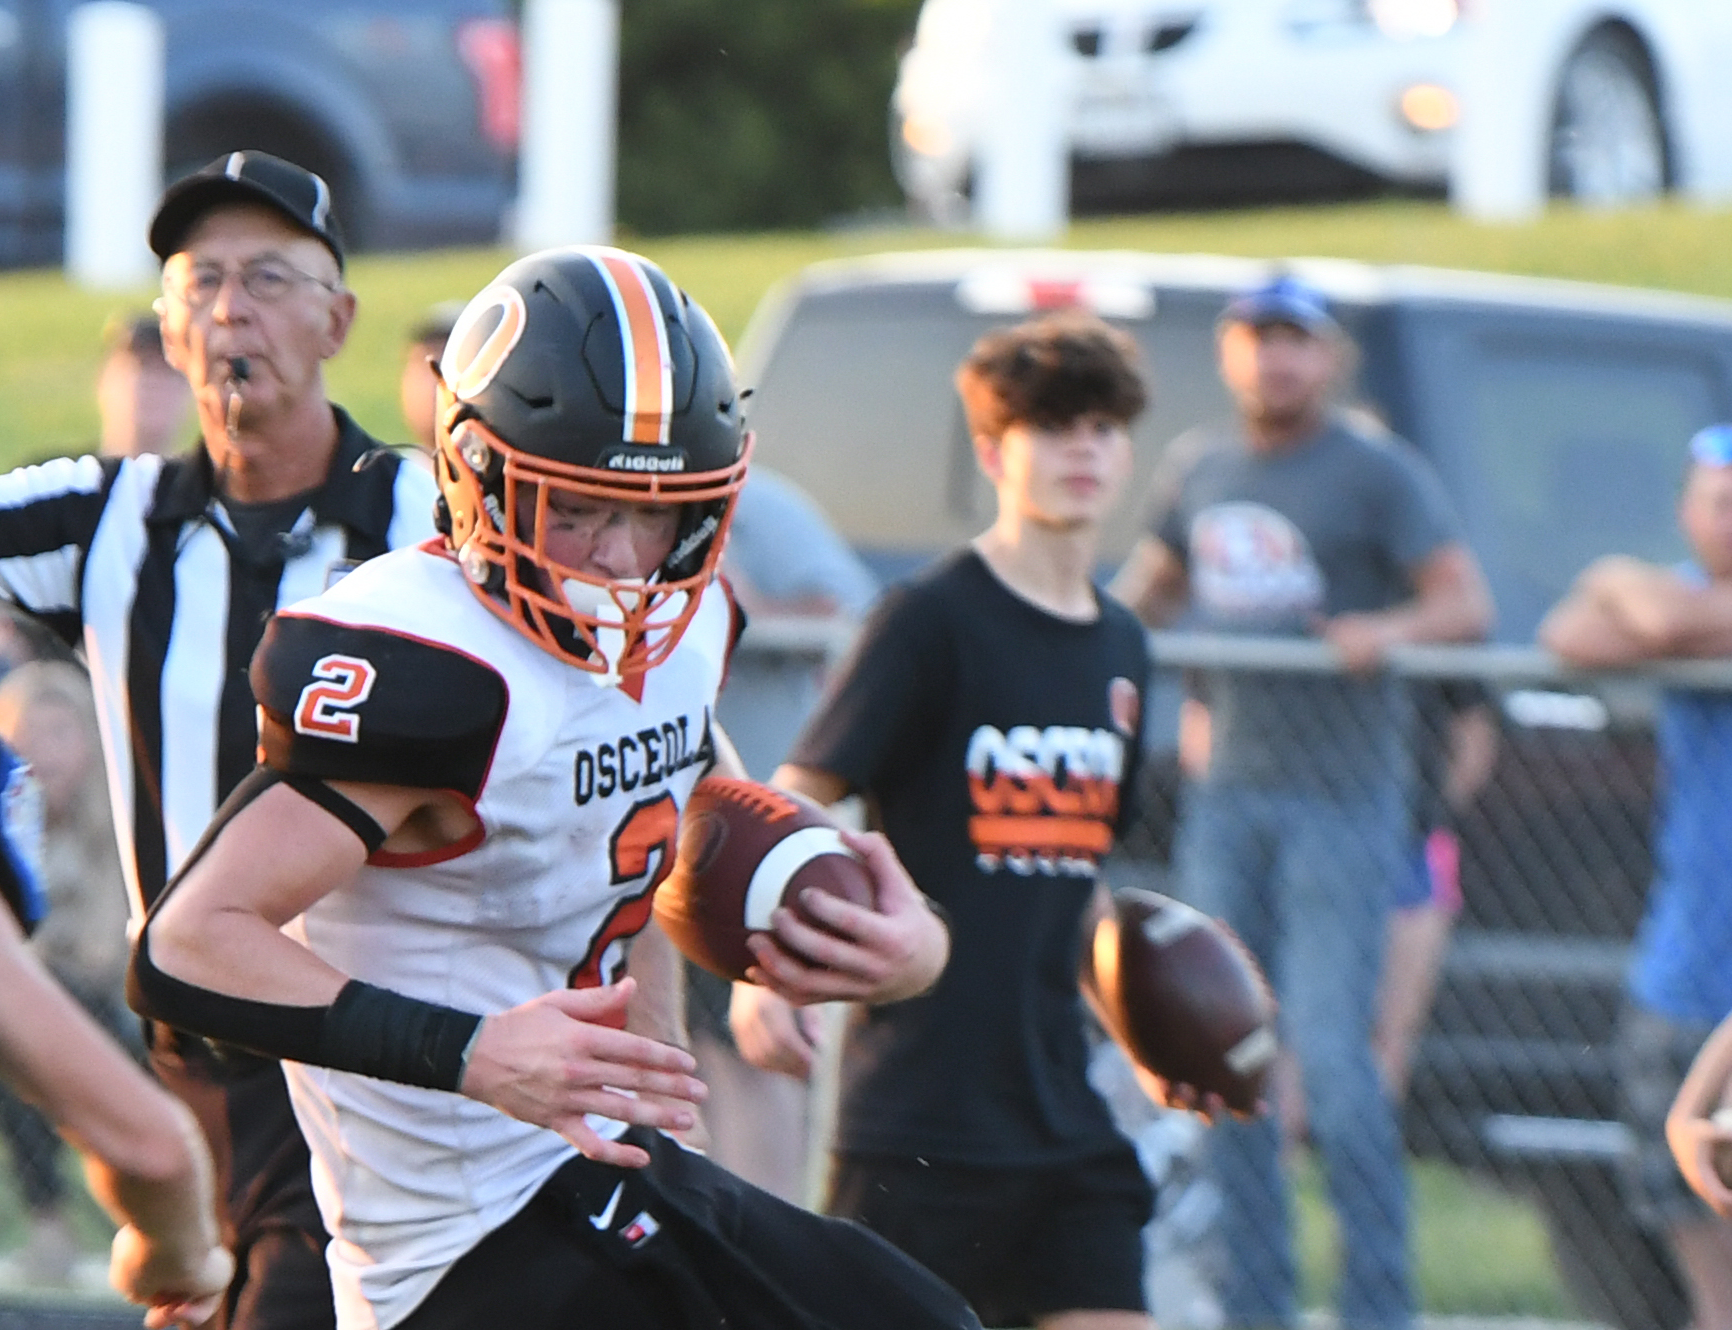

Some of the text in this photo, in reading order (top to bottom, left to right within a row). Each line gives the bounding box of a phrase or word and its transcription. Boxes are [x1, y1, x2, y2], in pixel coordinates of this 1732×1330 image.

[439, 285, 527, 400] O
[293, 653, 377, 744] 2
[573, 704, 717, 806] OSCEOLA
[566, 788, 682, 1032] 2
